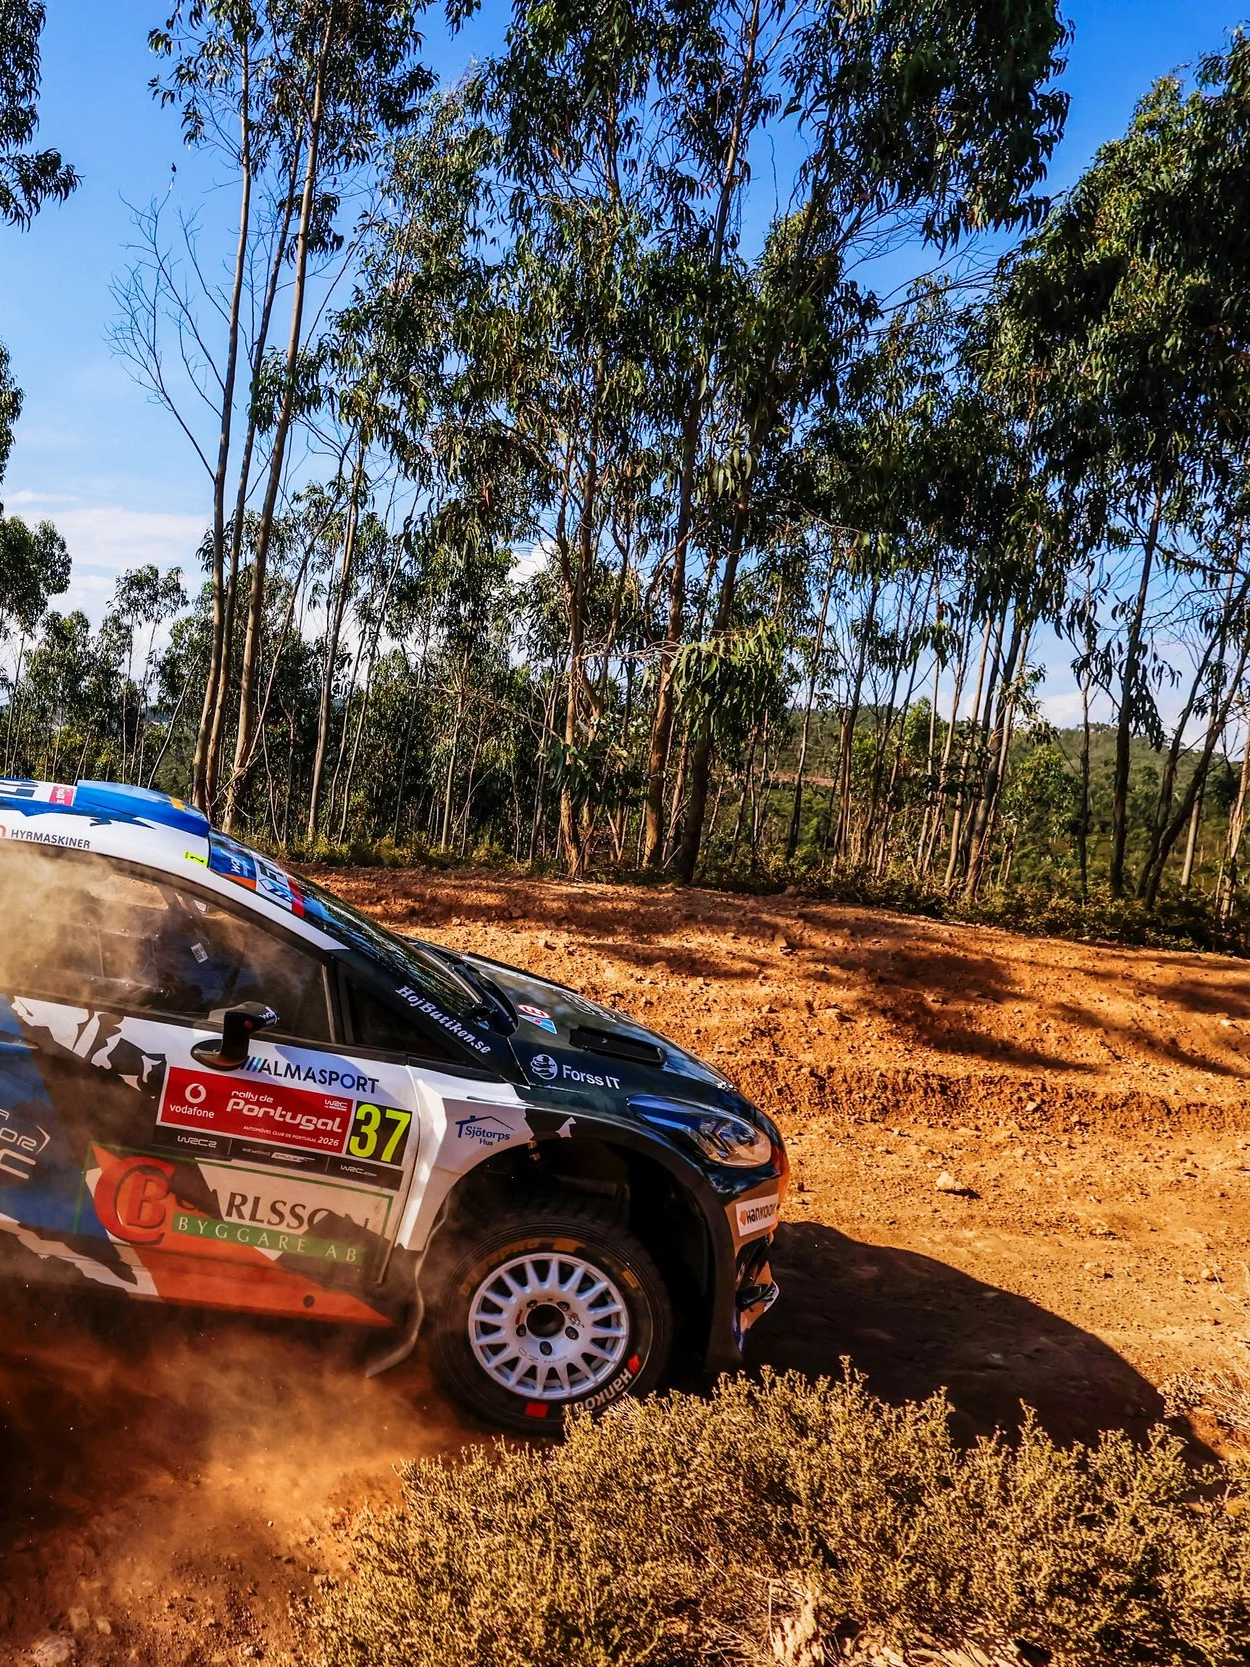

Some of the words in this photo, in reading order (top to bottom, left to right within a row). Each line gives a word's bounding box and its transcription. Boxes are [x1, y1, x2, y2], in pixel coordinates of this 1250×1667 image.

[10, 829, 91, 850] HYRMASKINER
[395, 985, 491, 1054] HojButiken.se
[258, 1058, 379, 1095] ALMASPORT
[562, 1065, 604, 1086] Forss
[605, 1075, 621, 1090] IT
[231, 1090, 258, 1102] rally
[259, 1095, 274, 1104] de
[169, 1103, 215, 1119] vodafone
[225, 1098, 343, 1133] Portugal
[177, 1135, 218, 1149] WRC2
[317, 1136, 340, 1147] 2026
[349, 1103, 411, 1163] 37
[465, 1124, 511, 1141] Sjötorps
[479, 1138, 493, 1146] Hus
[178, 1216, 307, 1253] BYGGARE
[325, 1244, 357, 1262] AB
[572, 1368, 633, 1414] Hankoo
